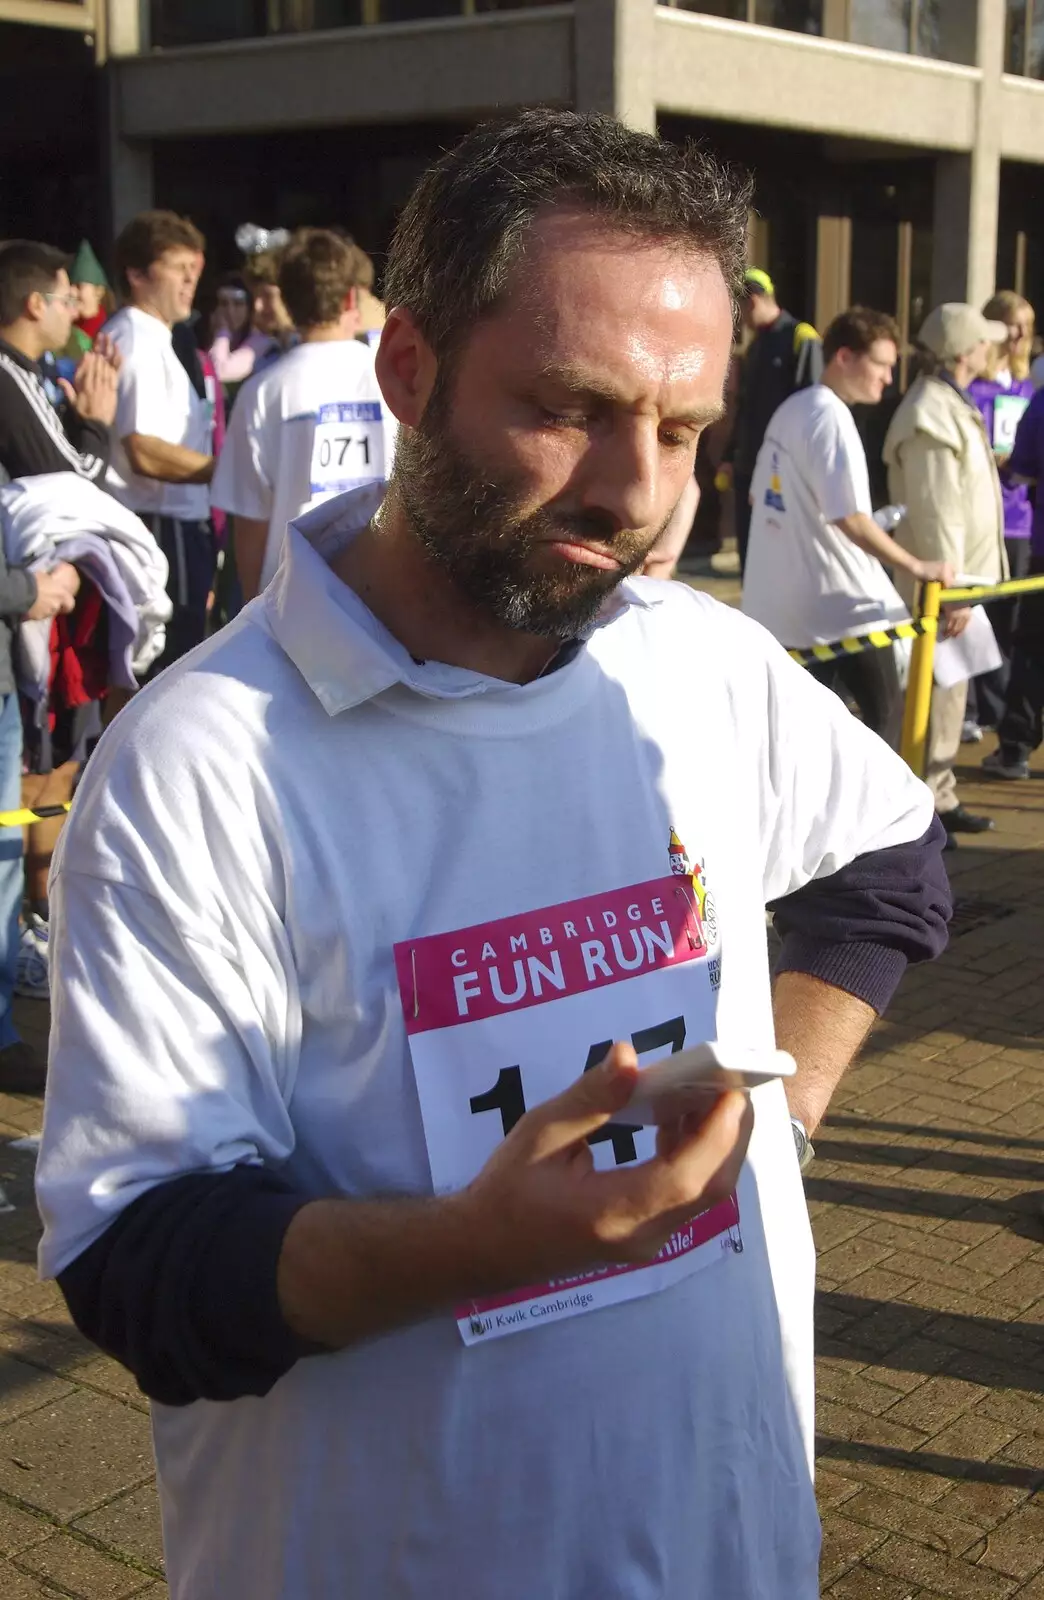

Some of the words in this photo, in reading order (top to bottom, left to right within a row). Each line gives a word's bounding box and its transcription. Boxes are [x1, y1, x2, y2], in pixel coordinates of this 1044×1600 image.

[320, 436, 370, 467] 071
[451, 898, 665, 968] CAMBRIDGE
[452, 950, 566, 1017] FUN
[580, 920, 675, 982] RUN
[495, 1311, 527, 1328] Kwik
[529, 1292, 594, 1318] Cambridge
